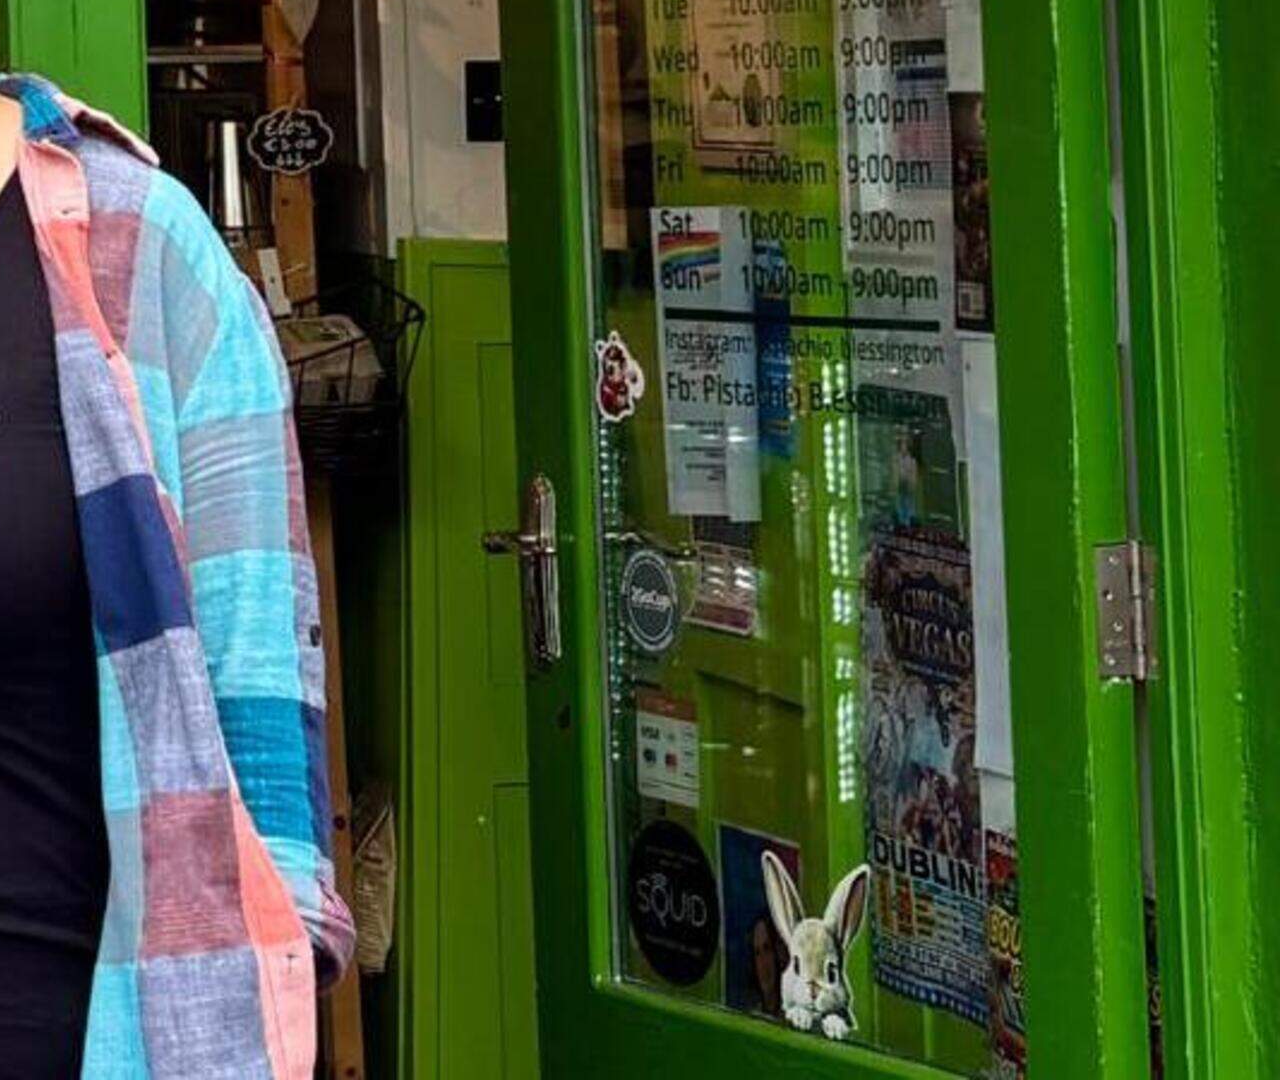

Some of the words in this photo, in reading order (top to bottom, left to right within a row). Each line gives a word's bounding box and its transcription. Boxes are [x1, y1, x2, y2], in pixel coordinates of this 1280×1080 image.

[652, 41, 700, 71] Wed
[731, 40, 821, 70] 10:00am
[841, 35, 927, 73] 9:00pm
[653, 99, 694, 129] Thu
[843, 92, 929, 133] 9:00pm
[656, 153, 684, 183] Fri
[736, 153, 826, 184] 10:00am
[846, 154, 933, 193] 9:00pm
[659, 209, 694, 236] Sat
[738, 209, 829, 240] 10:00am
[849, 210, 936, 251] 9:00pm
[659, 263, 701, 291] Sun
[741, 266, 833, 298] 10:00am
[851, 268, 938, 308] 9:00pm
[665, 328, 752, 358] Instagram:
[666, 371, 698, 404] Fb:
[892, 610, 971, 666] VEGAS
[873, 833, 977, 900] DUBLIN
[636, 875, 708, 928] SQUID
